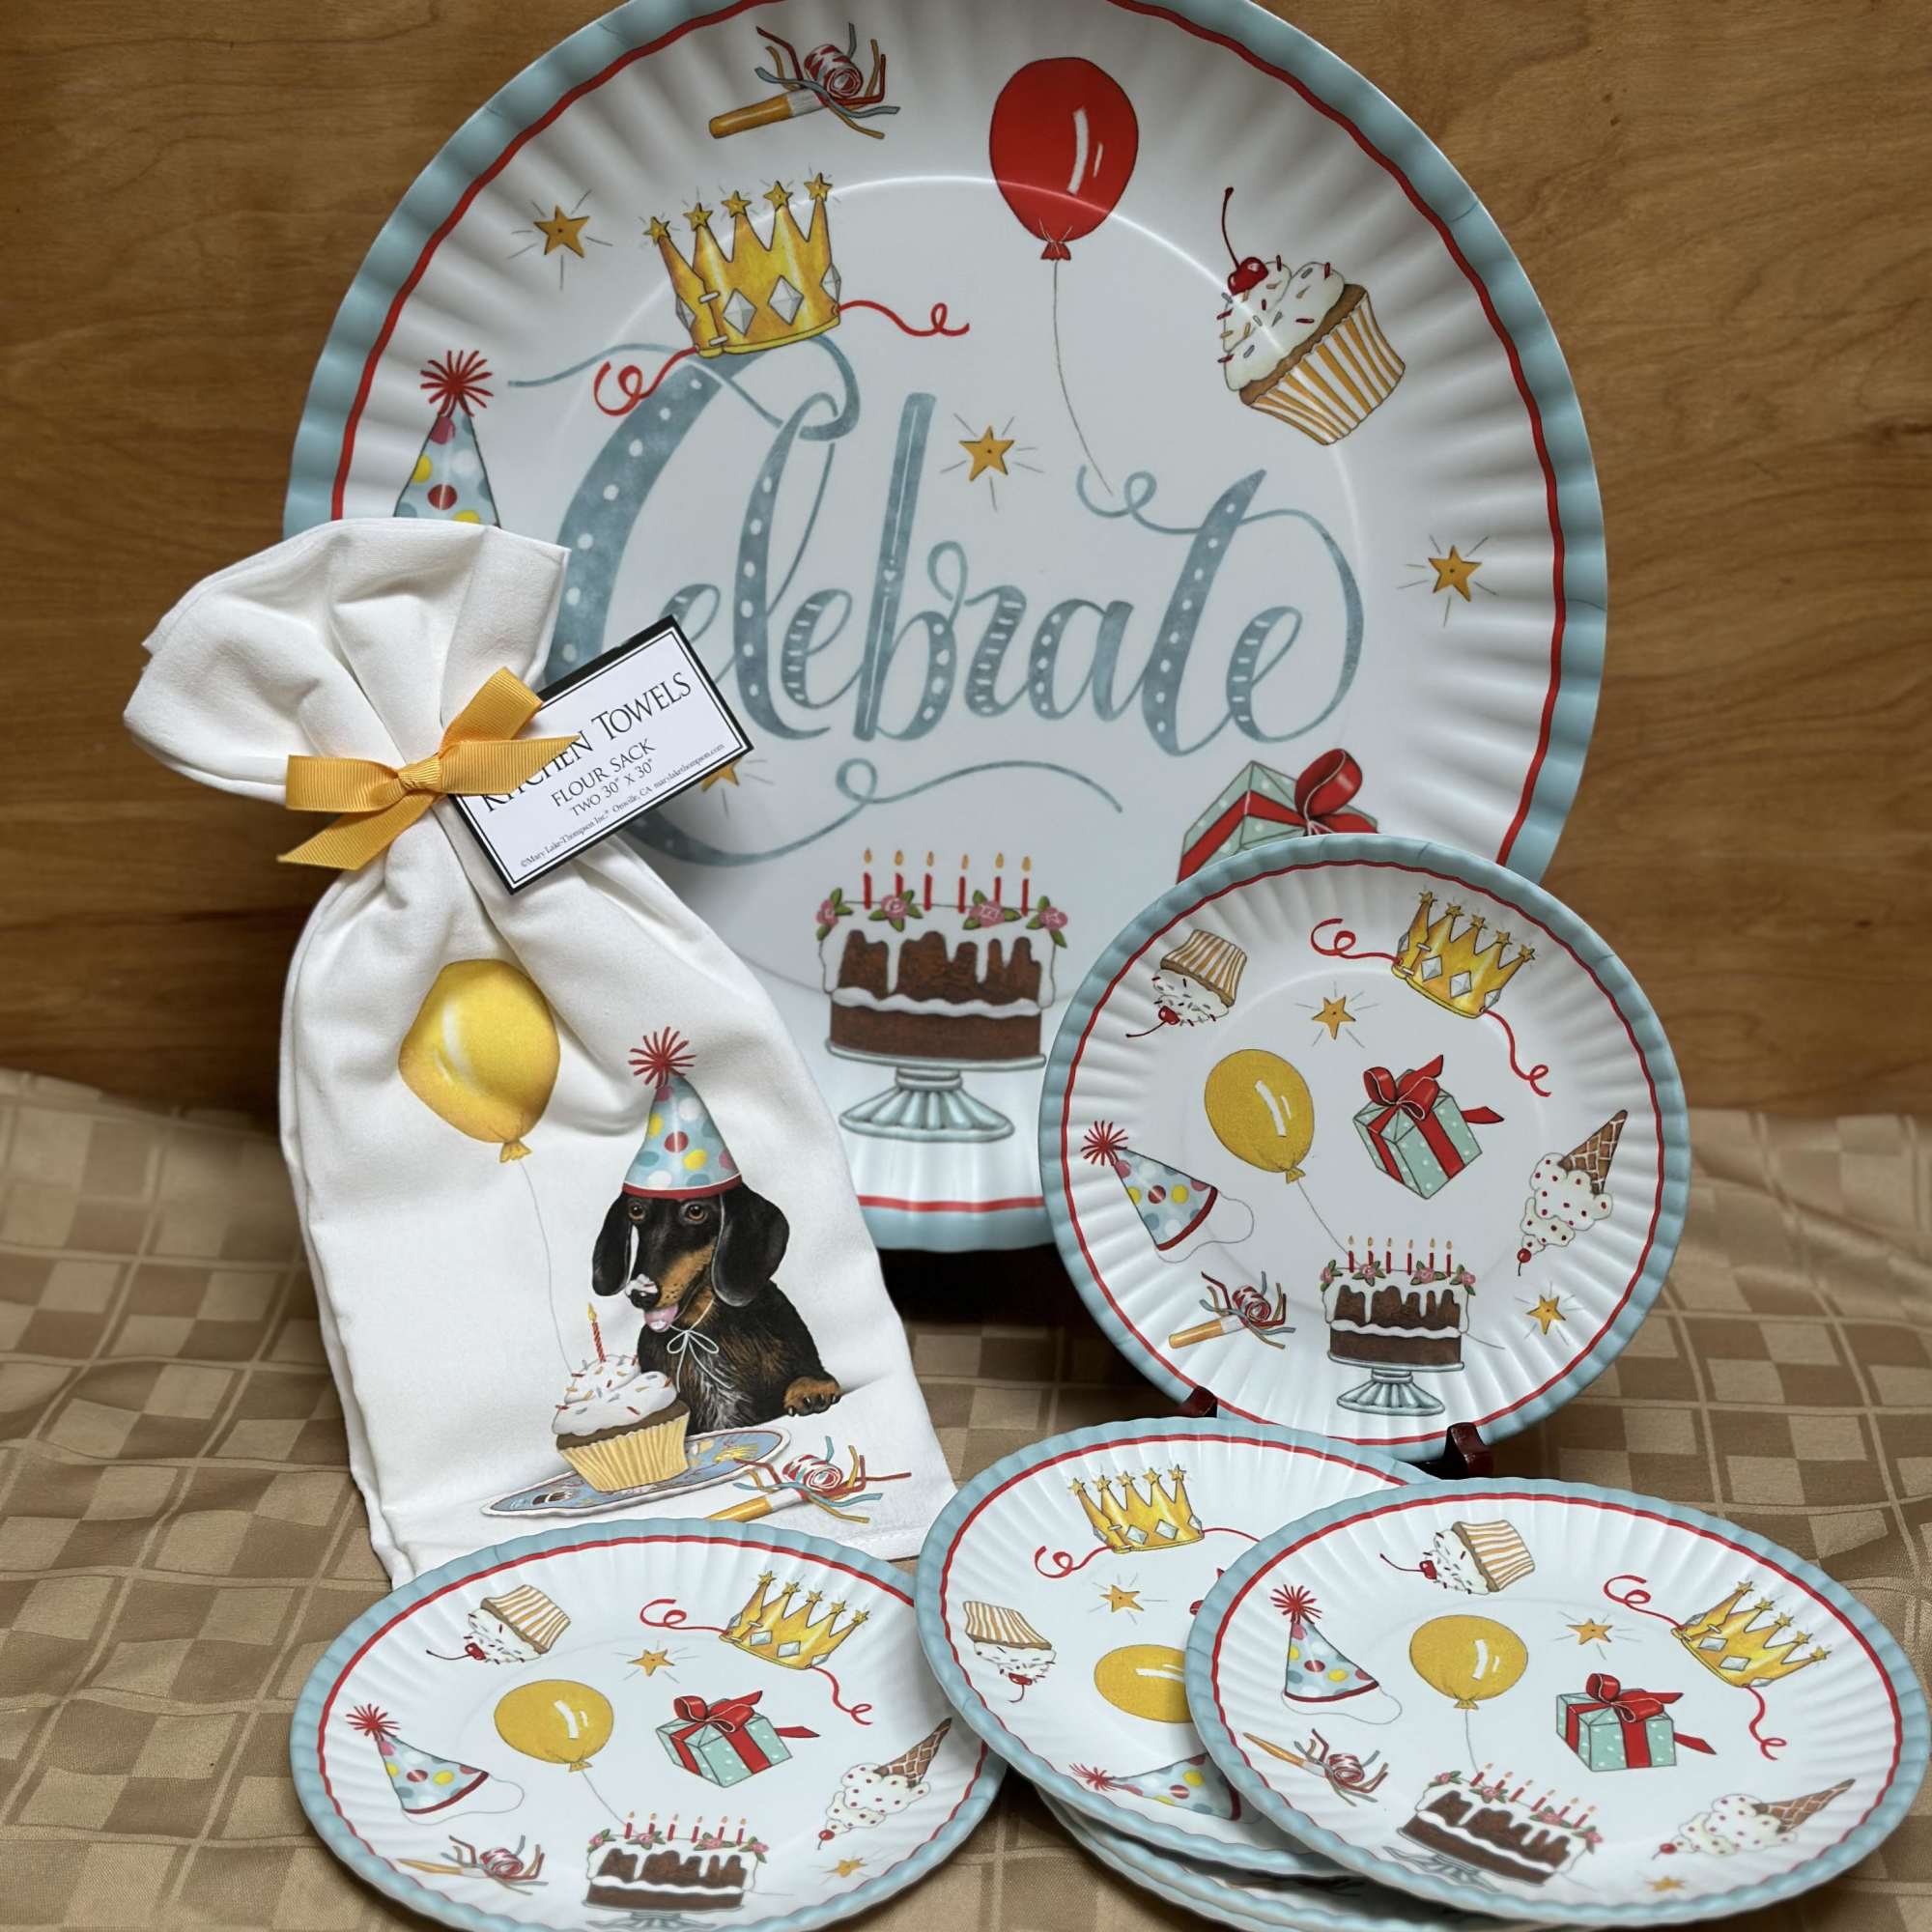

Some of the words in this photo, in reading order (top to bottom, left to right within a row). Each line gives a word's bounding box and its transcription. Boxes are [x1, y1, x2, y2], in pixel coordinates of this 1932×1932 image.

[509, 333, 1364, 865] Celebrate
[590, 671, 692, 740] TOWELS
[551, 768, 610, 807] FLOUR
[610, 738, 656, 773] SACK
[571, 795, 601, 816] TWO
[639, 786, 652, 797] CA
